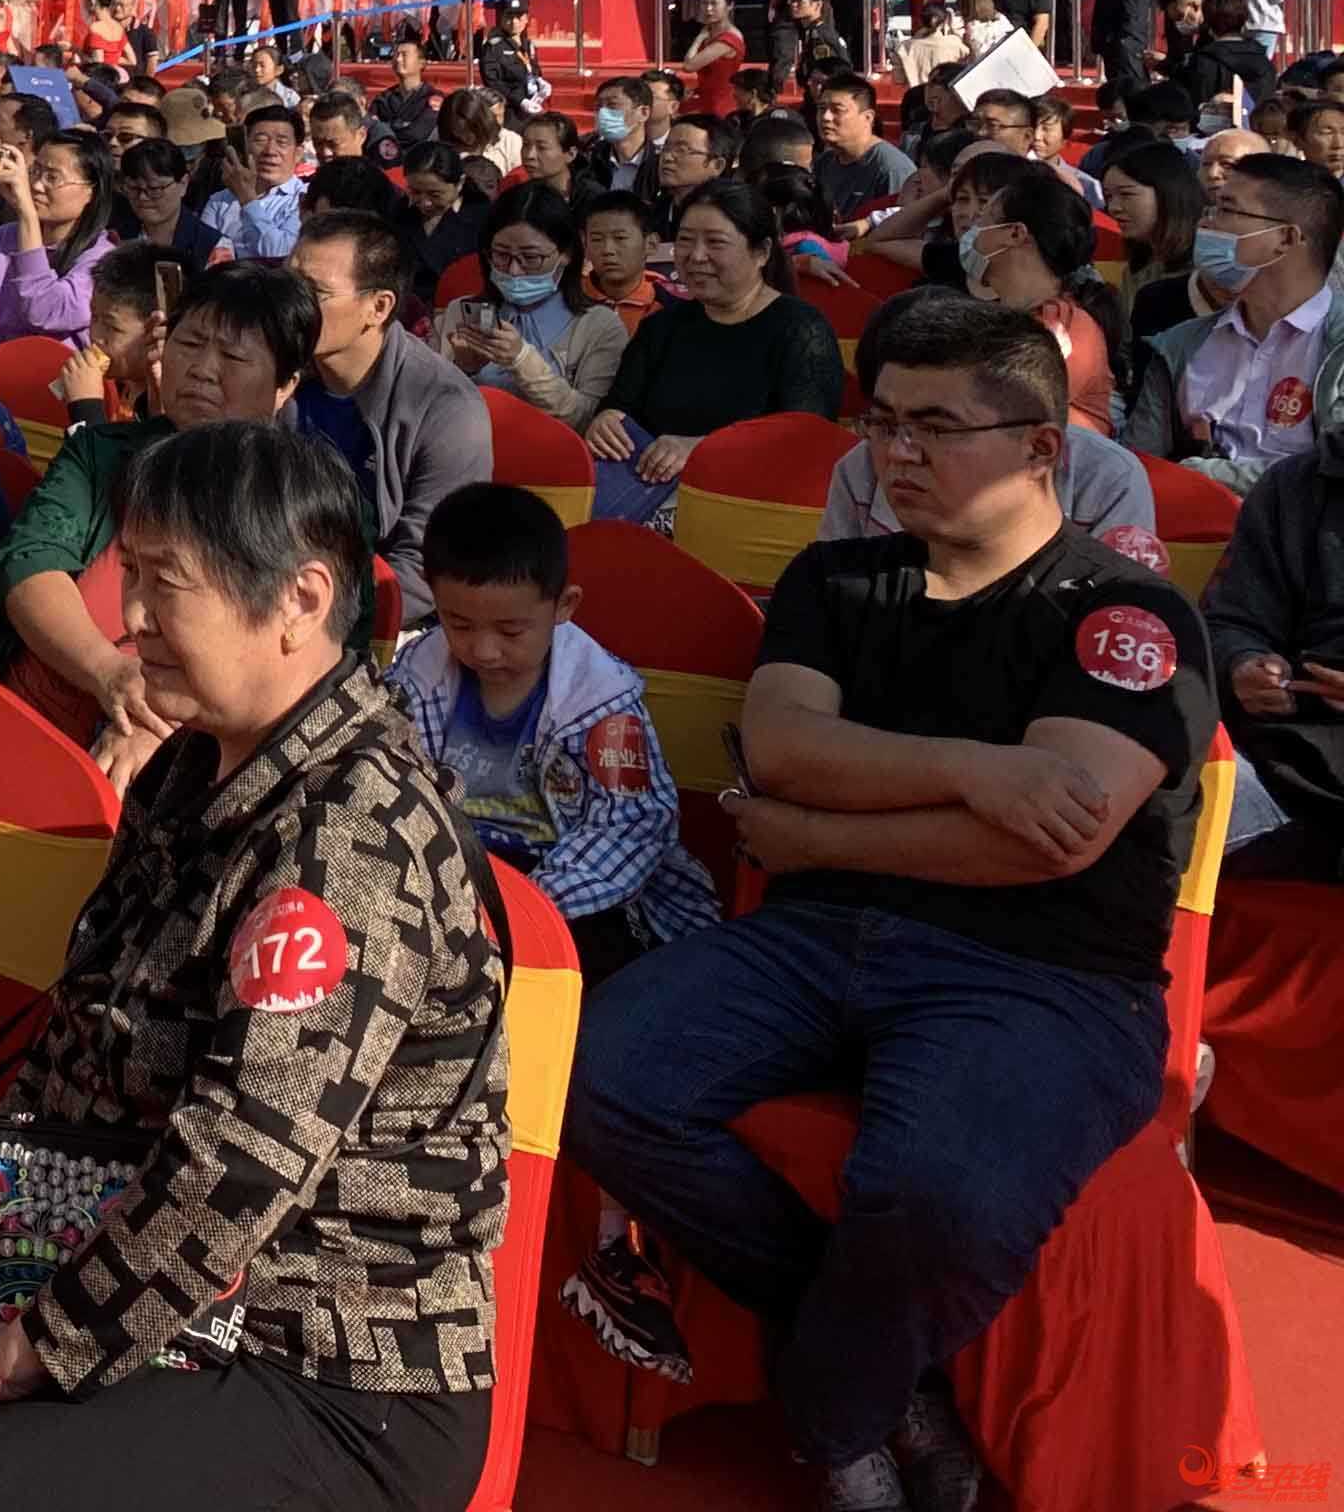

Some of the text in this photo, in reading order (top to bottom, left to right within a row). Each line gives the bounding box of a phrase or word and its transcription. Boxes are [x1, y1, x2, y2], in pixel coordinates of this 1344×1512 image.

[1272, 395, 1303, 416] 169
[1093, 629, 1161, 671] 136
[243, 927, 327, 979] 172
